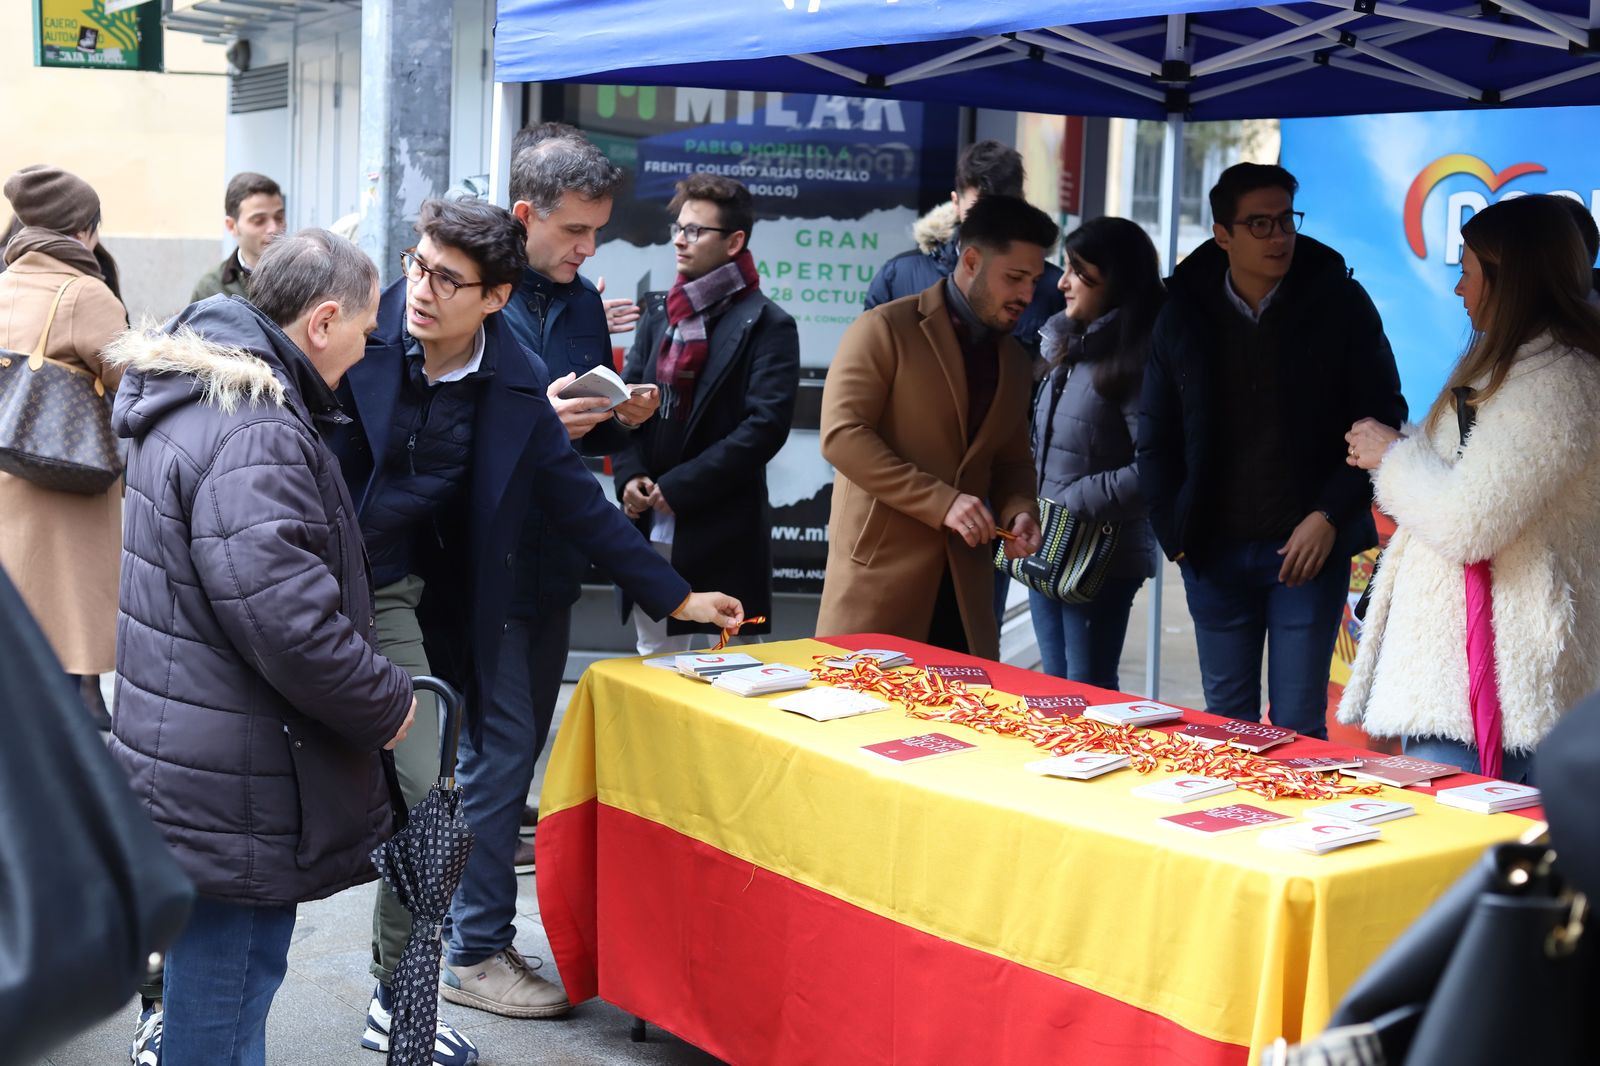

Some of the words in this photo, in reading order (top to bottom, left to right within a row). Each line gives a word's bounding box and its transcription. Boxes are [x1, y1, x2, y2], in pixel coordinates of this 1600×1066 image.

[685, 138, 743, 155] PABLO
[644, 160, 693, 174] FRENTE
[695, 163, 758, 177] COLEGIO
[759, 166, 802, 179] ARIAS
[804, 169, 871, 182] GONZALO
[795, 229, 879, 250] GRAN
[770, 287, 793, 302] 28
